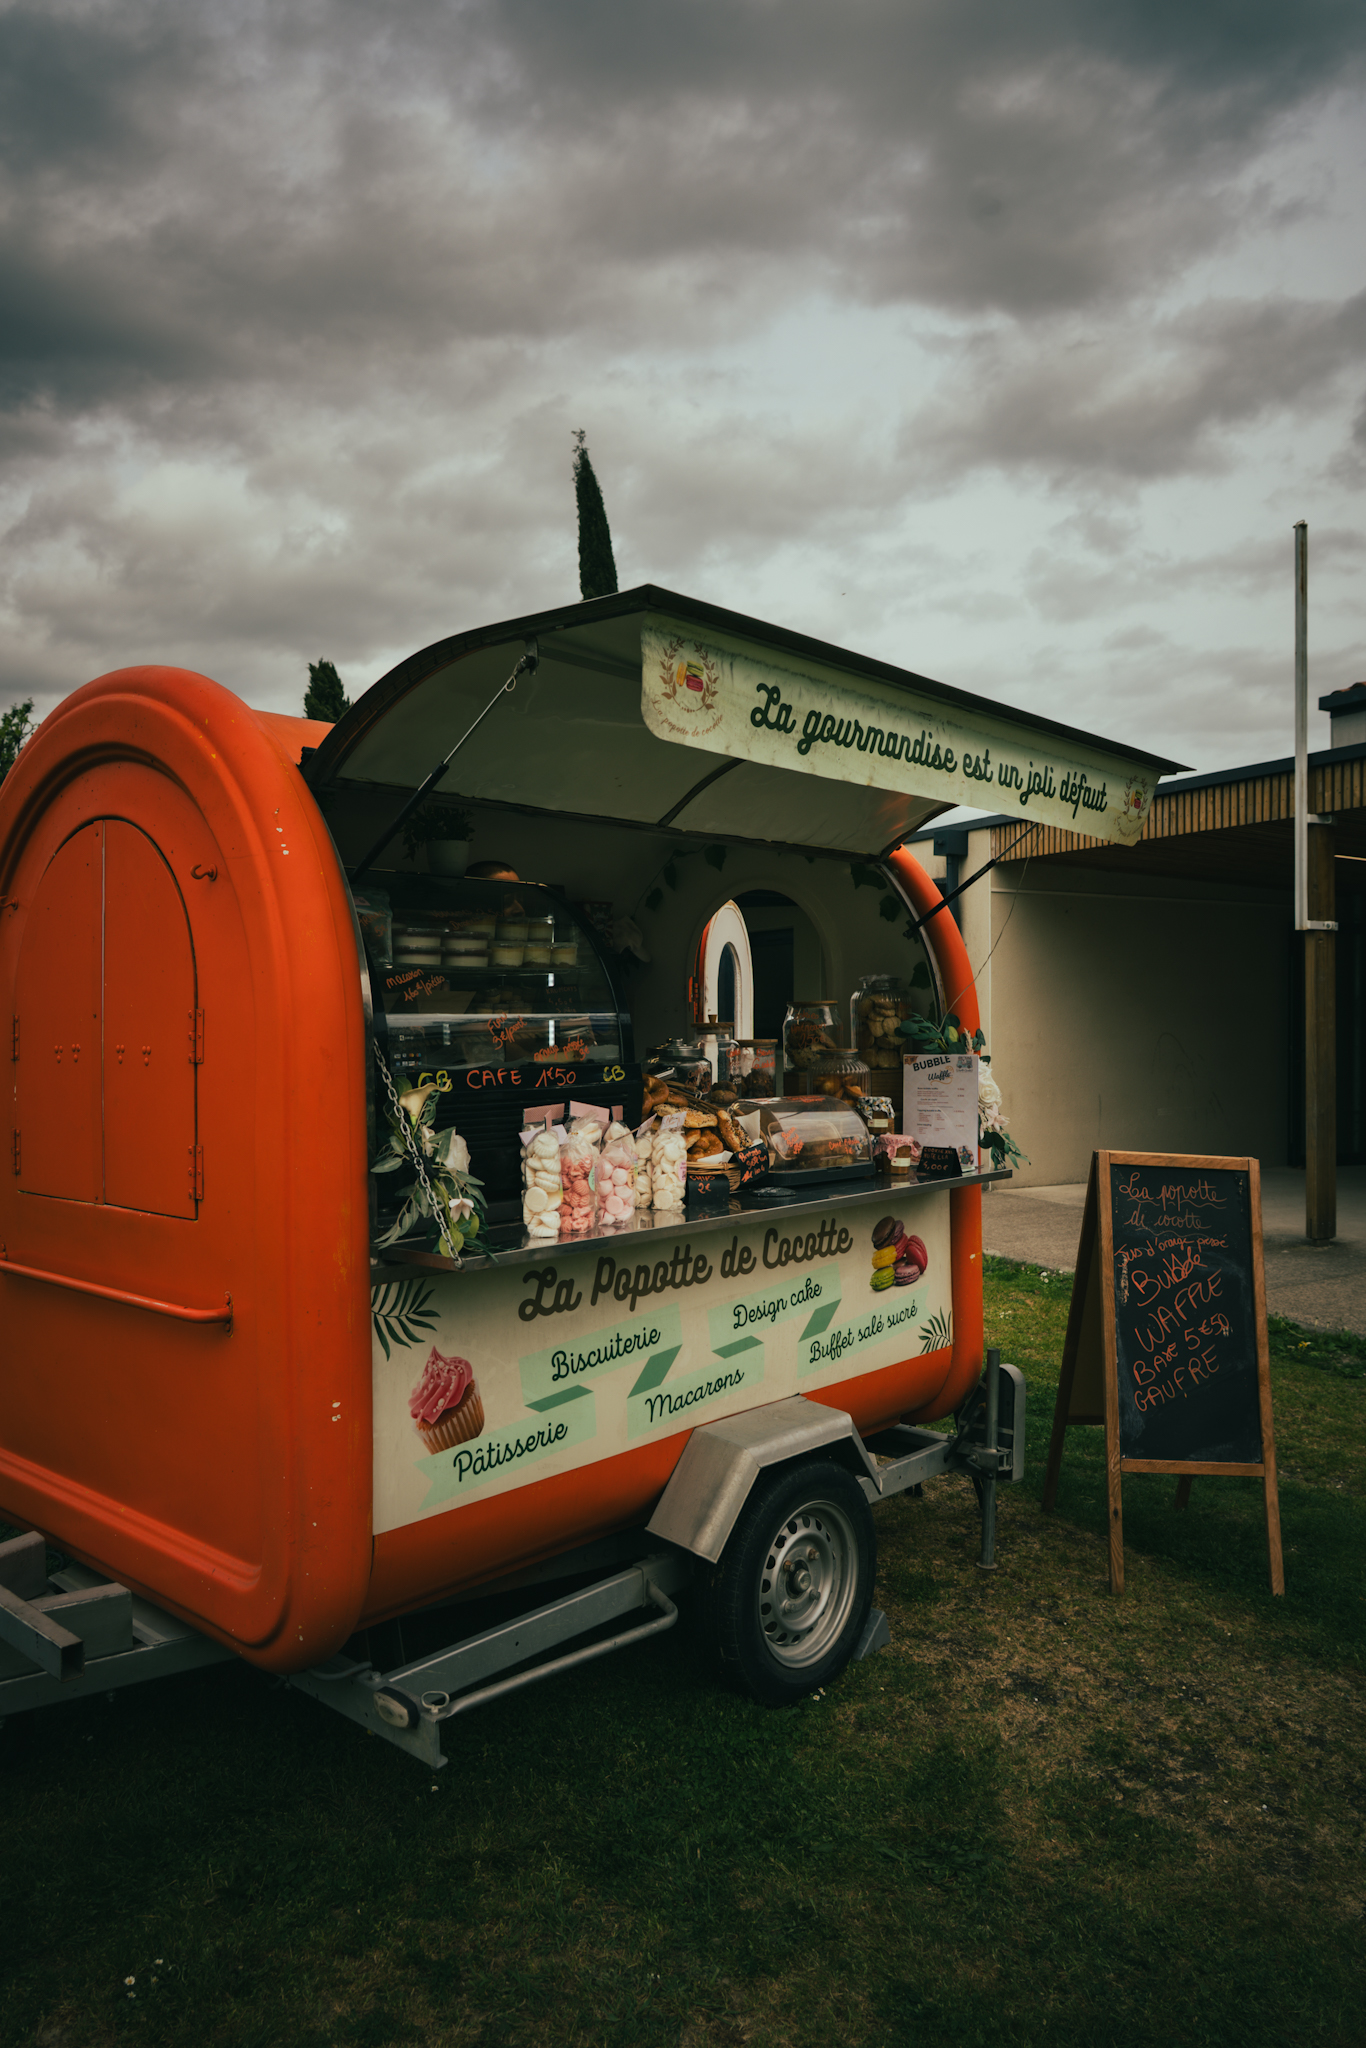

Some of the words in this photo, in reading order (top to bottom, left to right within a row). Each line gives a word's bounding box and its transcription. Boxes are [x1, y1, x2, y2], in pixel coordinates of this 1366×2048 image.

[661, 717, 690, 736] popotte
[691, 726, 699, 737] de
[750, 683, 796, 735] La
[797, 709, 957, 772] gourmandise
[962, 748, 993, 783] est
[998, 763, 1024, 788] un
[1019, 761, 1056, 806] joli
[1059, 771, 1108, 819] défaut
[603, 1065, 626, 1083] CB
[913, 1056, 951, 1072] BUBBLE
[928, 1069, 952, 1082] Waffle
[698, 1182, 711, 1194] 2€
[1119, 1172, 1154, 1200] La
[1156, 1179, 1228, 1212] popotte
[1124, 1203, 1149, 1229] de
[1154, 1208, 1212, 1230] cocotte
[518, 1266, 582, 1323] La
[590, 1243, 713, 1312] Popotte
[719, 1235, 757, 1278] de
[762, 1217, 854, 1276] Cocotte
[1114, 1243, 1142, 1268] Jus
[1146, 1237, 1195, 1257] d'orange
[732, 1298, 787, 1331] Design
[790, 1277, 823, 1310] cake
[550, 1324, 662, 1382] Biscuiterie
[809, 1327, 855, 1367] Buffet
[857, 1315, 885, 1344] salé
[887, 1303, 919, 1332] sucré
[644, 1365, 745, 1423] Macarons
[1134, 1344, 1220, 1412] GAUFRE
[452, 1419, 569, 1483] Pâtisserie
